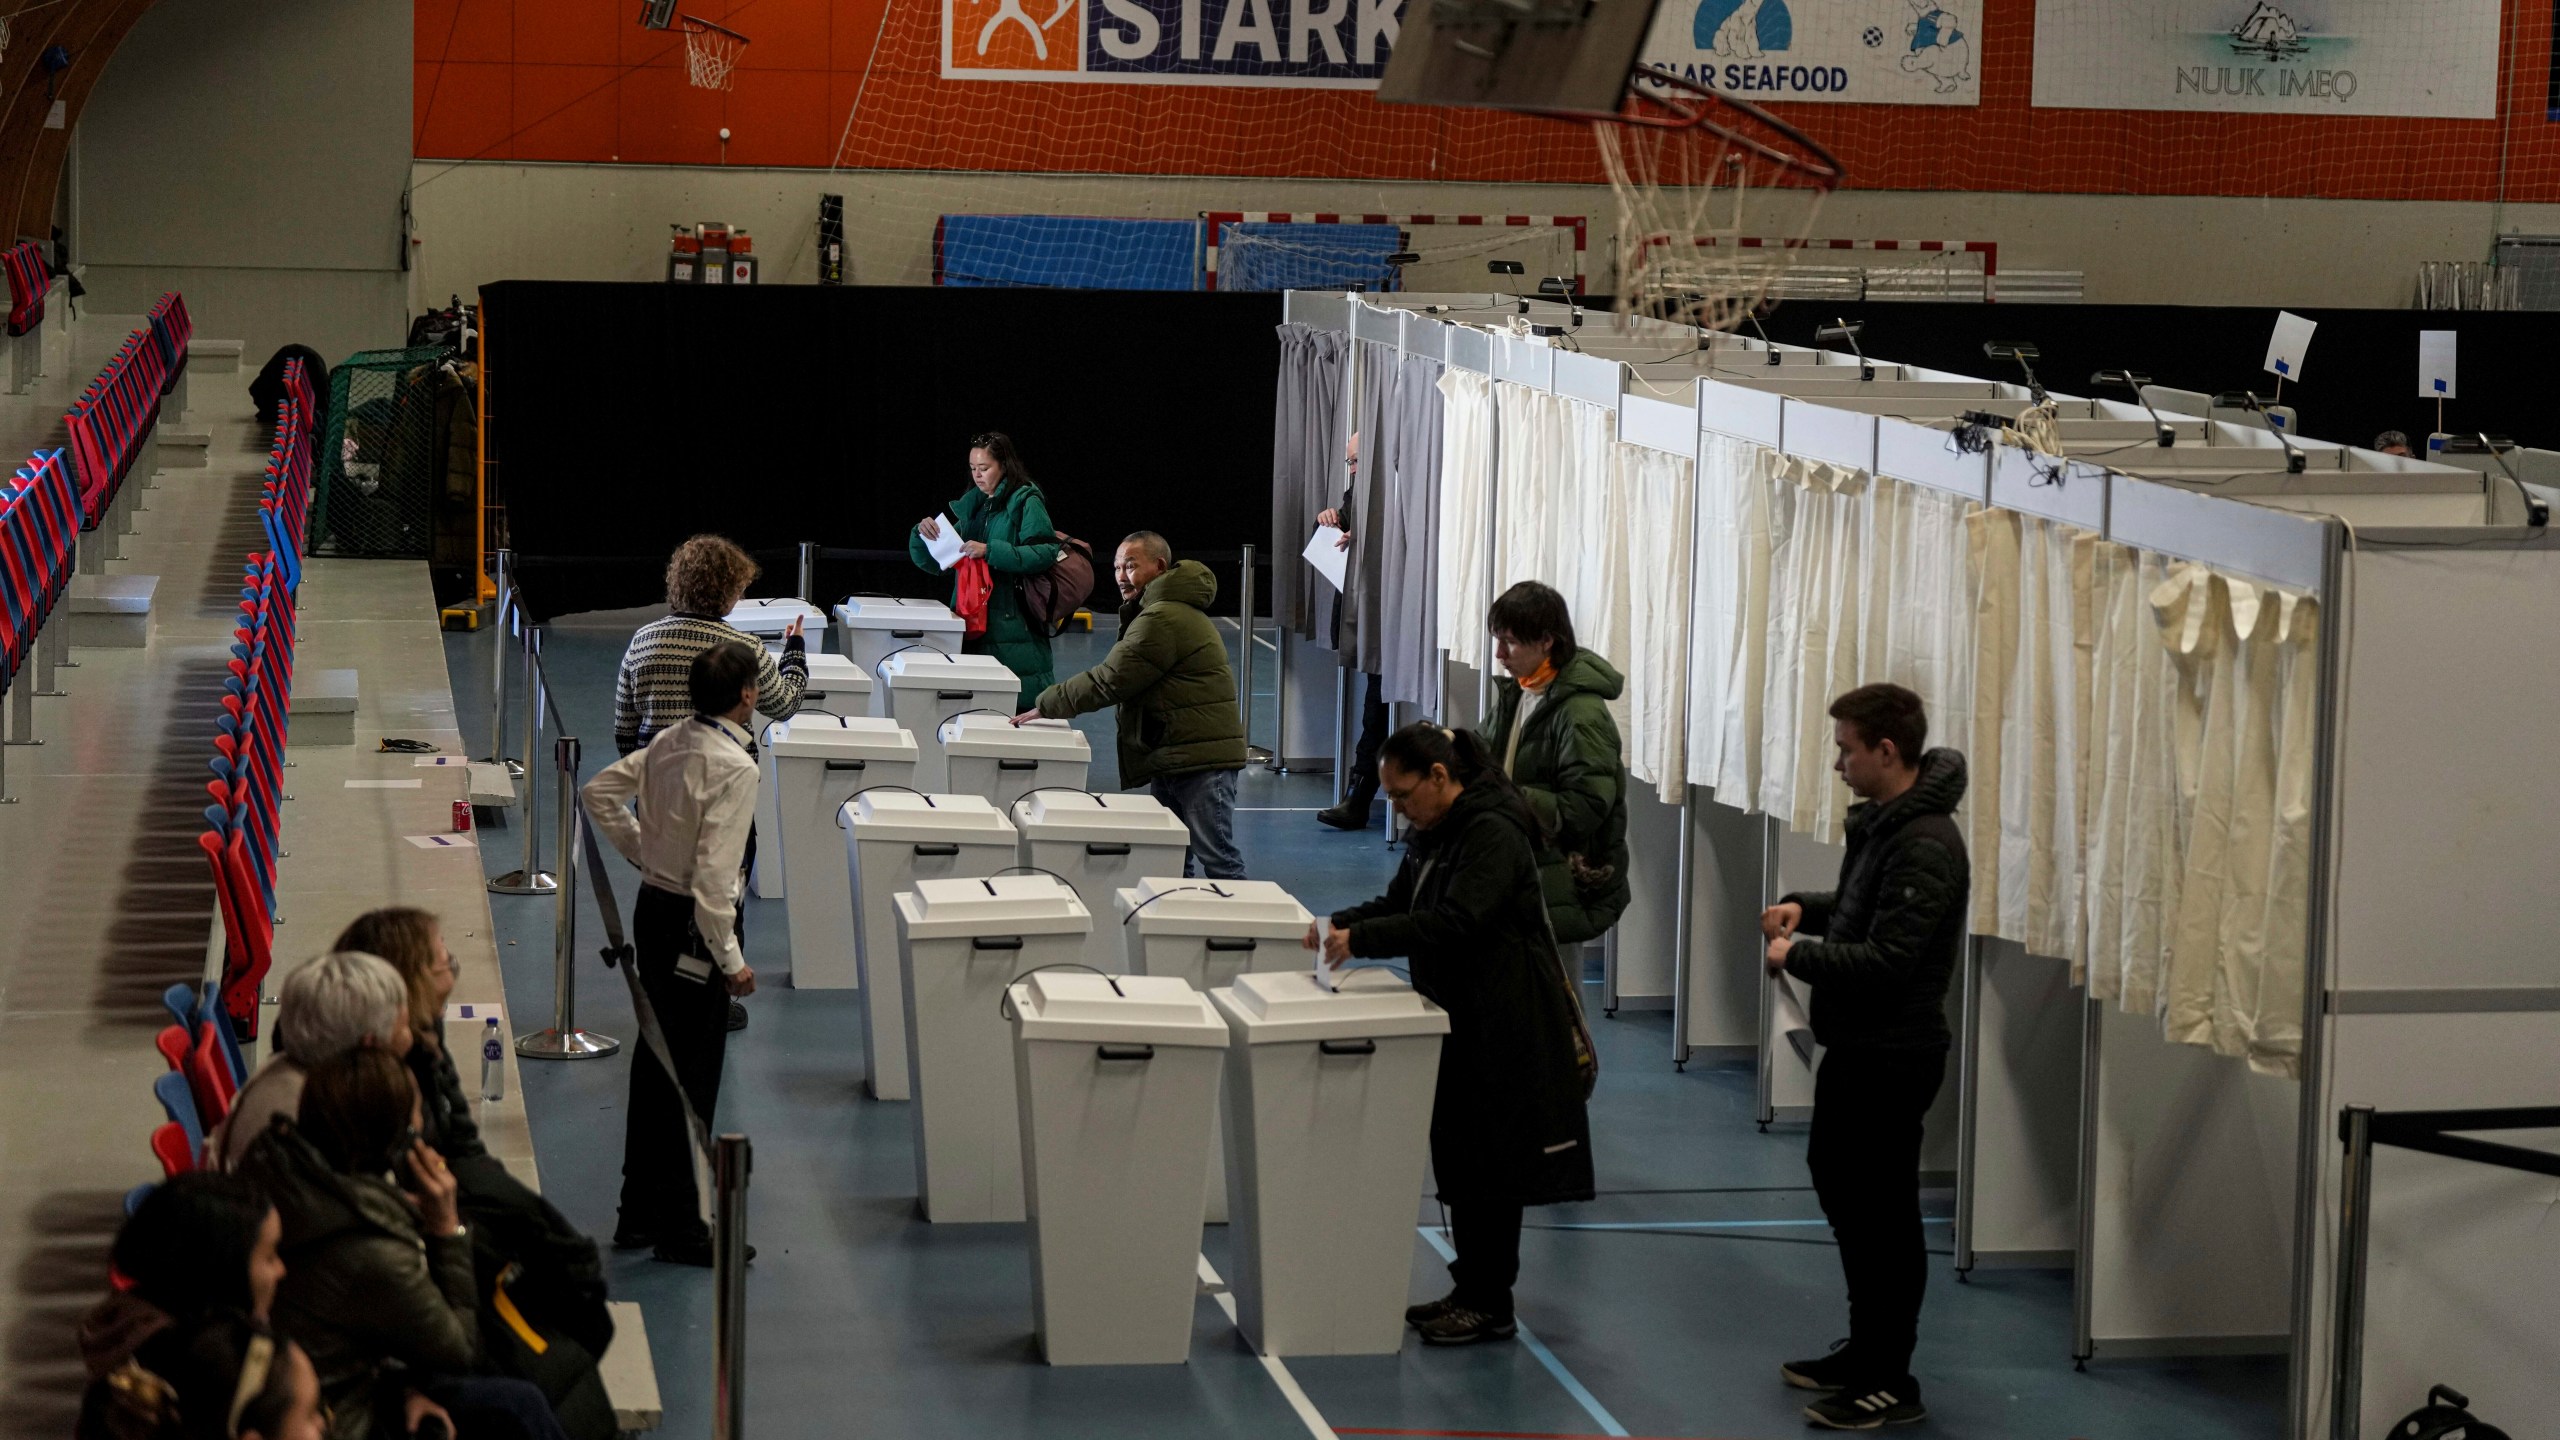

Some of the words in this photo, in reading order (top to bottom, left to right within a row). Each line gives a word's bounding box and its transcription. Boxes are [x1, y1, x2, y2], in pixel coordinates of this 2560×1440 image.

[1724, 64, 1848, 92] SEAFOOD
[2176, 66, 2265, 96] NUUK
[2279, 69, 2357, 103] IMEQ
